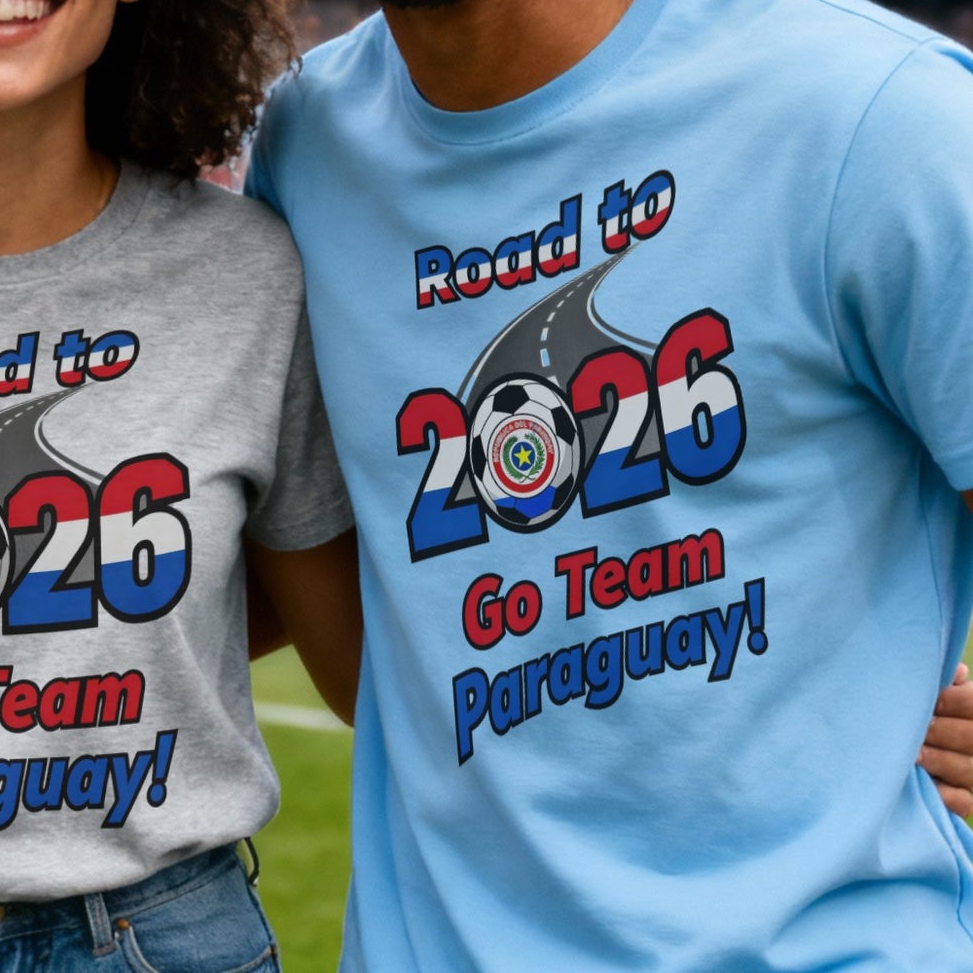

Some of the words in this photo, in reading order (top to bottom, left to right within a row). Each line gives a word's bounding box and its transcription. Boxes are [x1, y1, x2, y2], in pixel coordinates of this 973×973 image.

[415, 192, 582, 309] Road
[598, 169, 676, 255] to
[54, 329, 140, 389] to
[462, 573, 542, 651] Go
[555, 527, 726, 621] Team
[452, 577, 769, 766] Paraguay!
